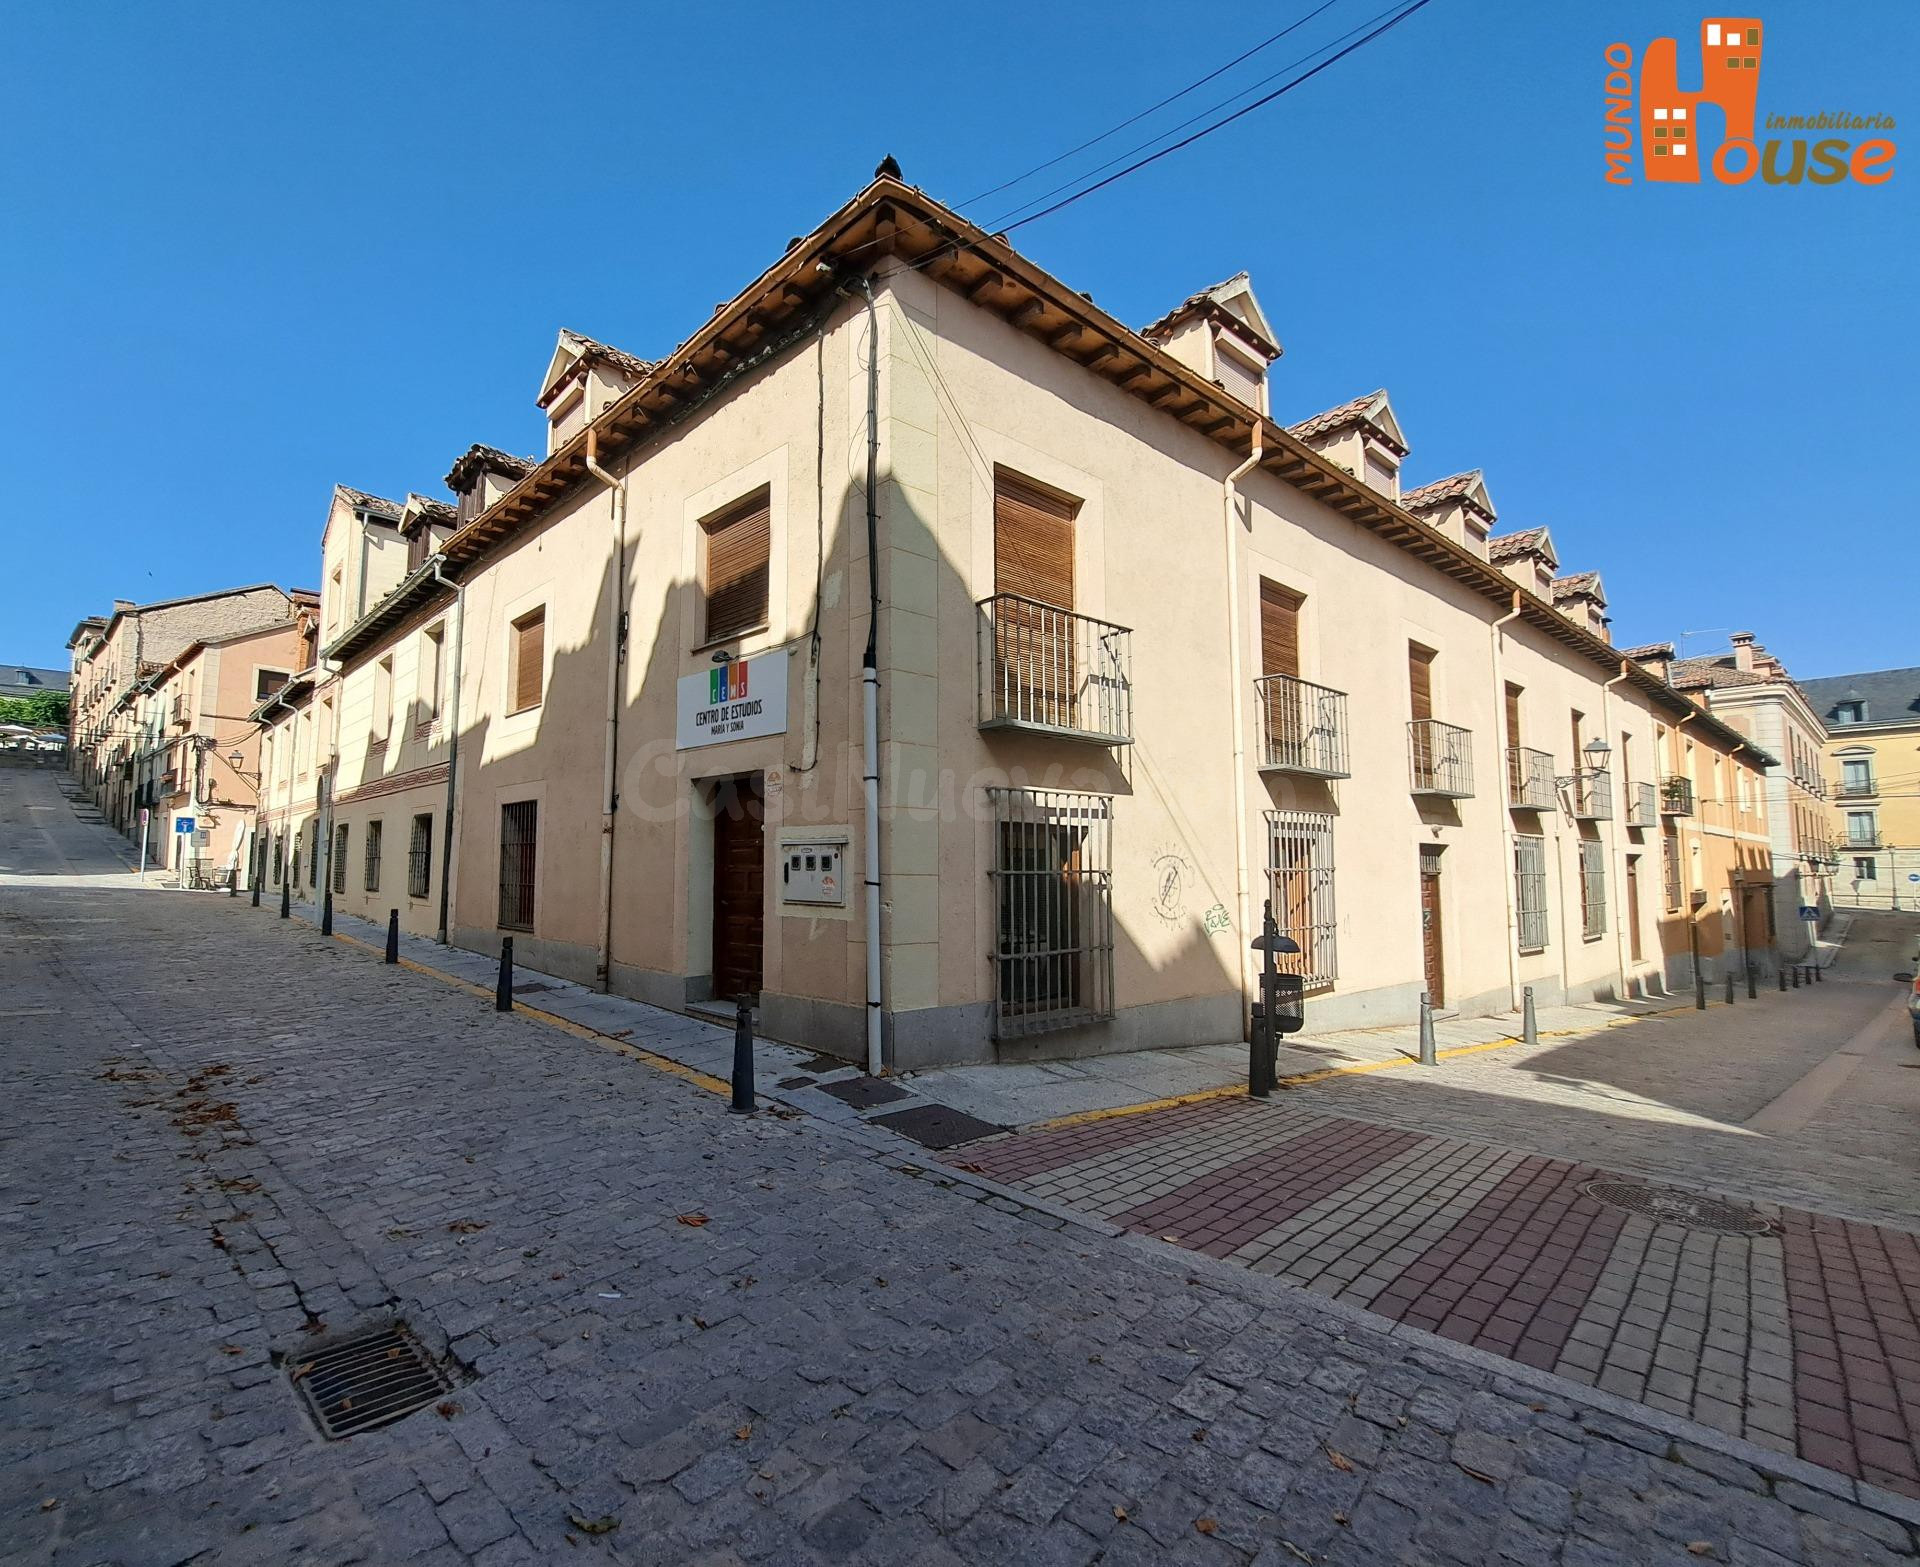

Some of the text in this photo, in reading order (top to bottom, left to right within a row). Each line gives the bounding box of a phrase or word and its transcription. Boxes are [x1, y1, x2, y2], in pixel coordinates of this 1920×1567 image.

[696, 700, 762, 726] CENTRO DE ESTUDIOS
[730, 721, 744, 732] SONIA
